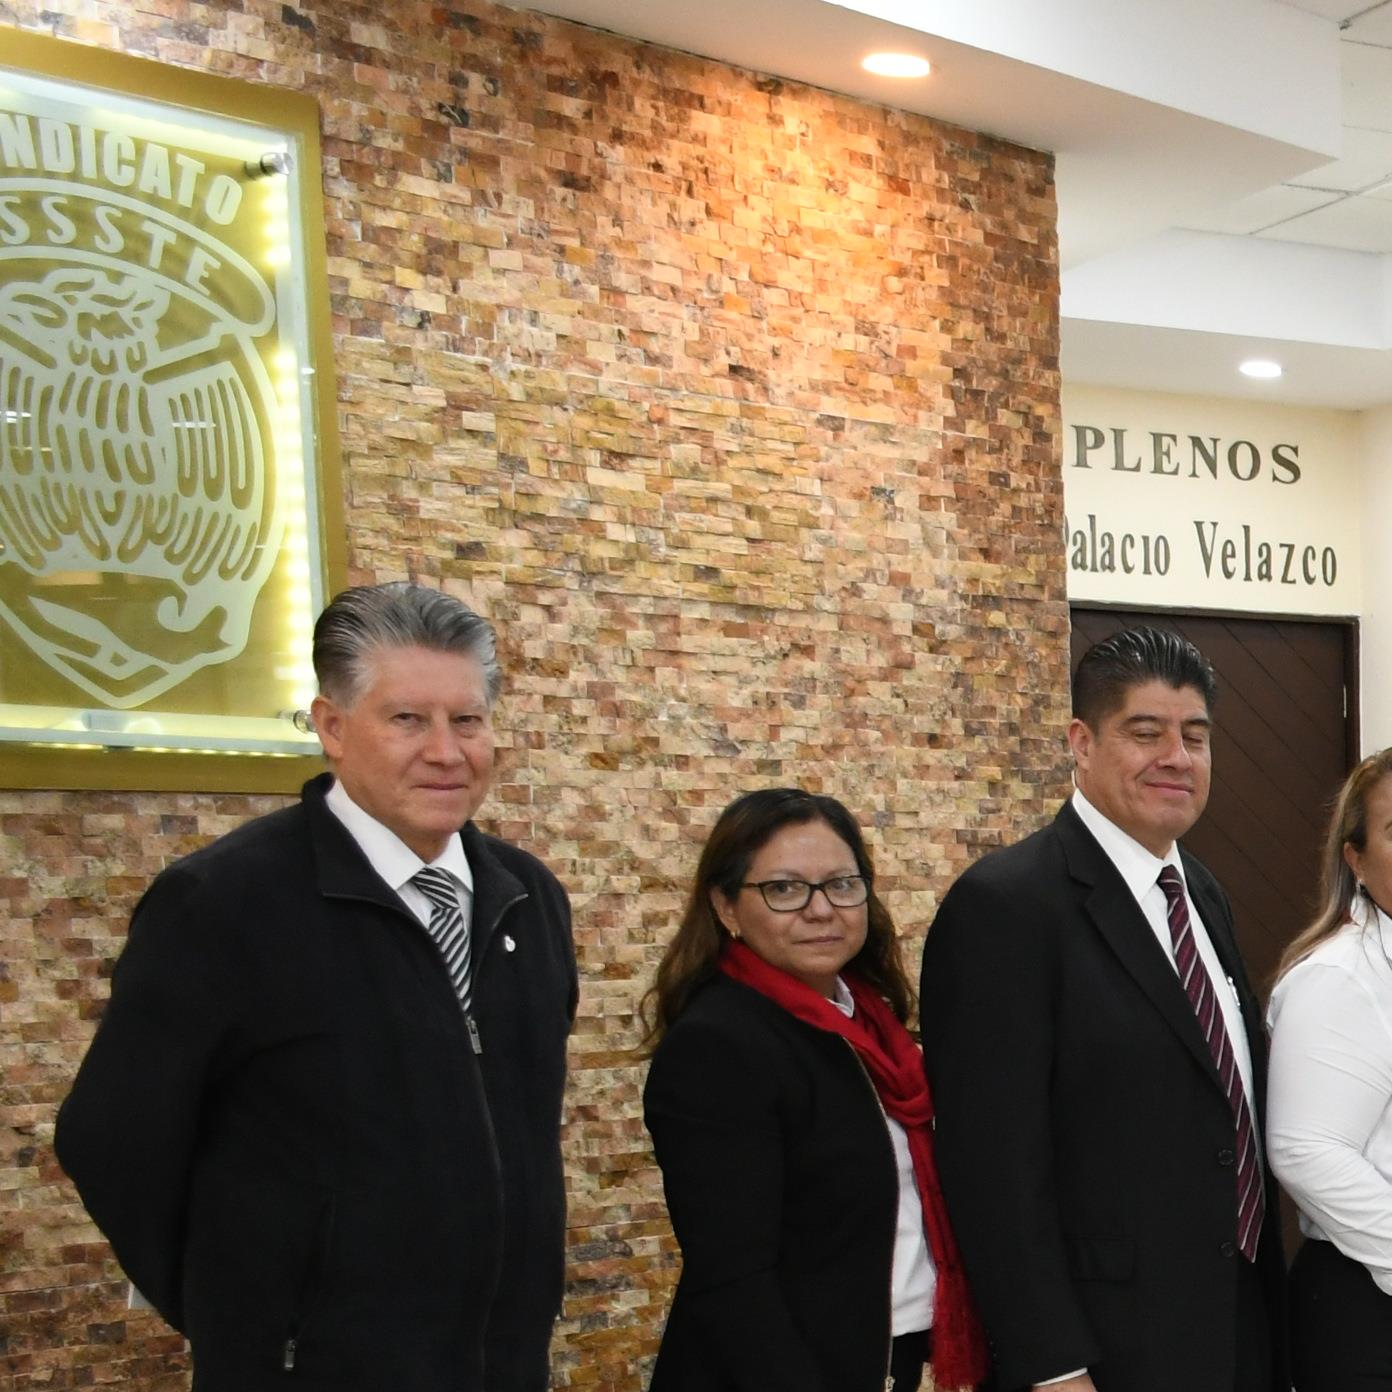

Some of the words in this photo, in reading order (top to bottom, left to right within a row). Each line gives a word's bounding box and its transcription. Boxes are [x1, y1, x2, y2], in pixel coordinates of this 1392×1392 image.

[1070, 424, 1302, 485] PLENOS
[1064, 514, 1171, 576] alacio
[1193, 520, 1338, 587] Velazco
